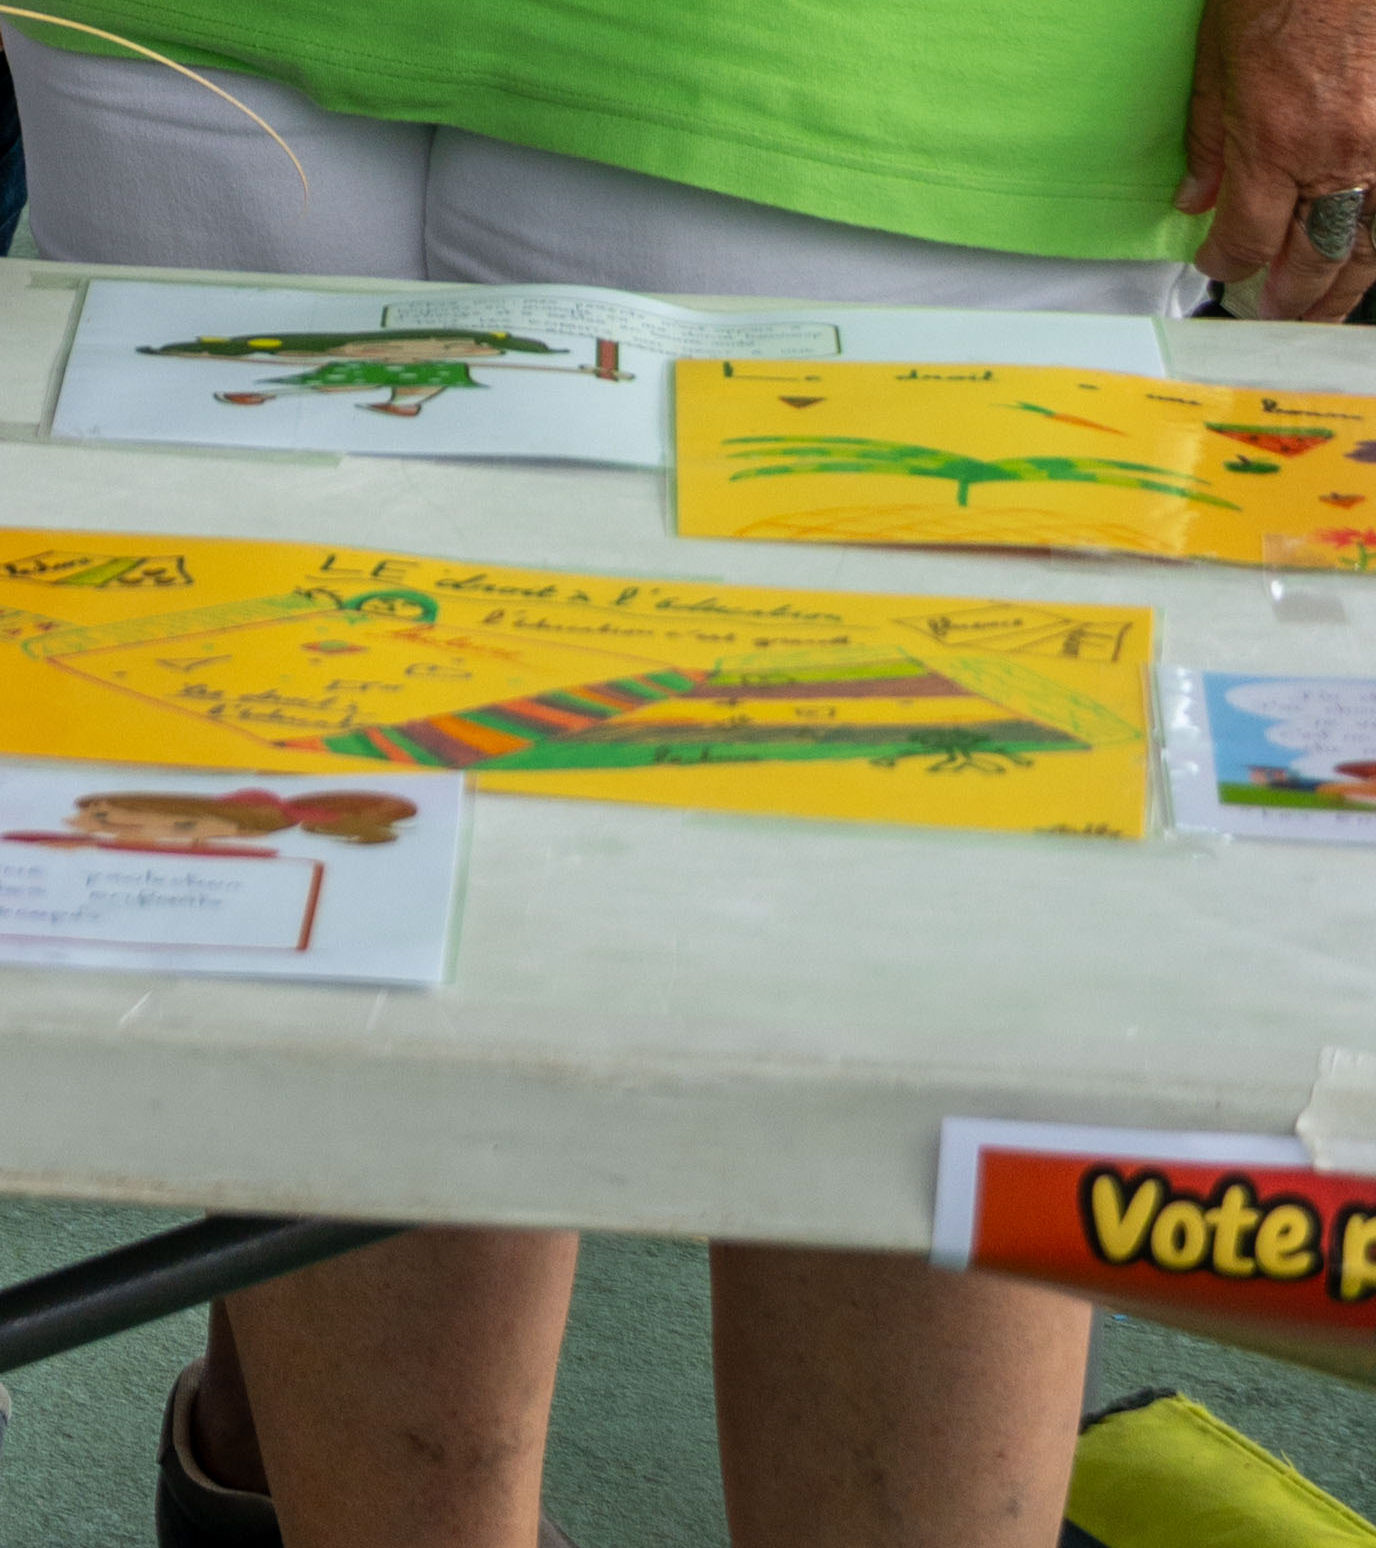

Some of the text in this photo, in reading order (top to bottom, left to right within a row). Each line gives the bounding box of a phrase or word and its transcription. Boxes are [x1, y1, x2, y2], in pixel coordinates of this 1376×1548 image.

[895, 368, 993, 382] droit
[434, 572, 559, 599] droit
[1084, 1167, 1321, 1279] Vote
